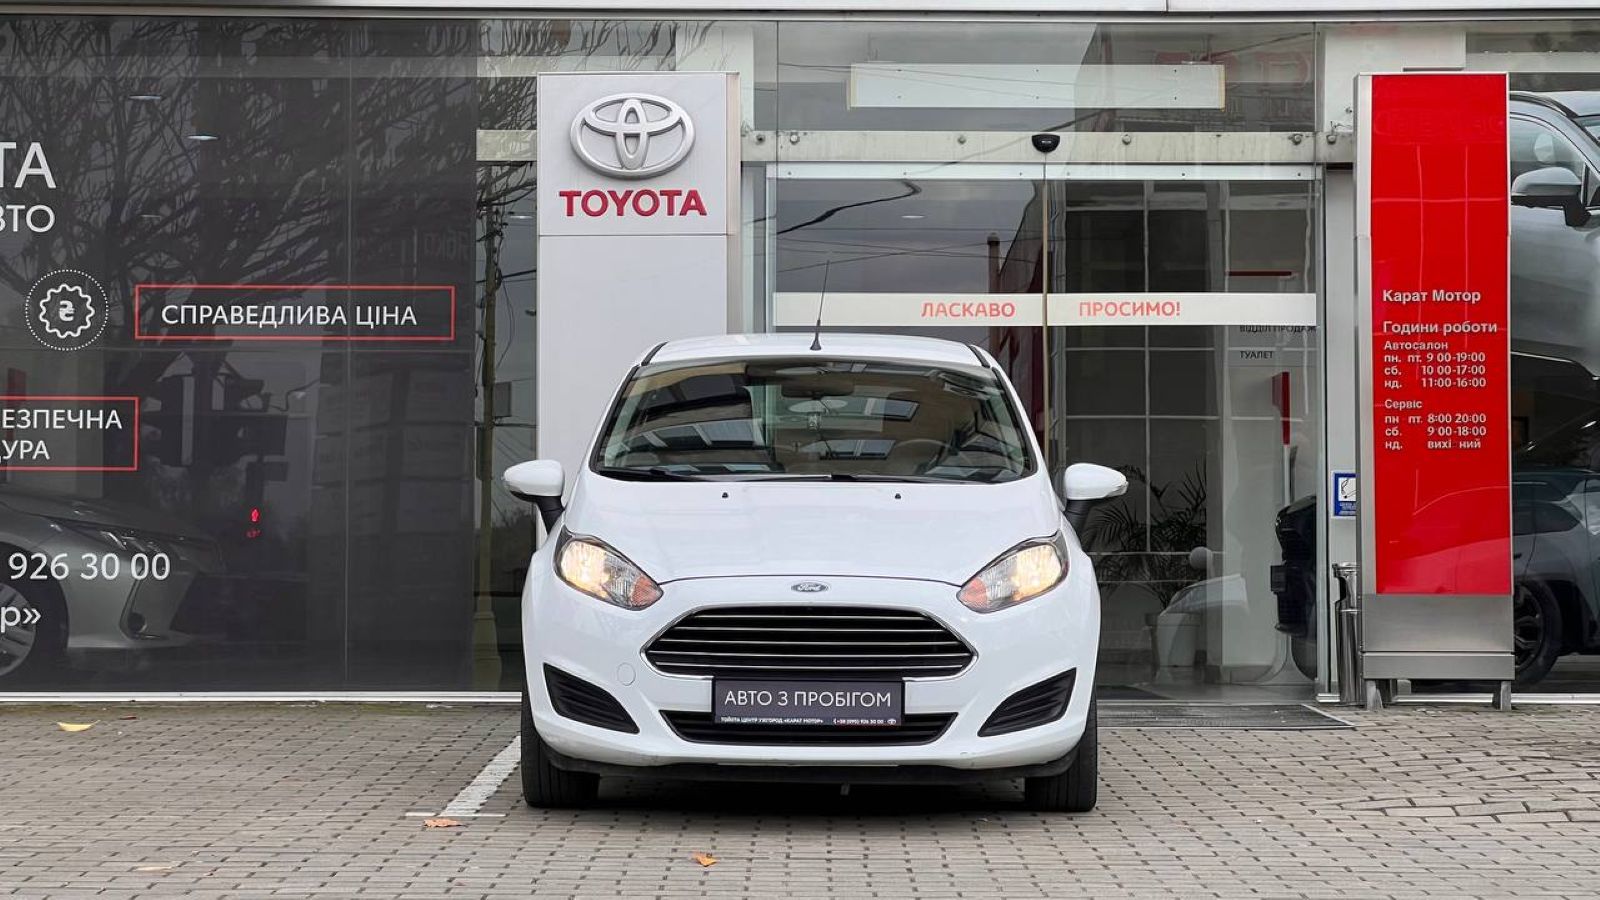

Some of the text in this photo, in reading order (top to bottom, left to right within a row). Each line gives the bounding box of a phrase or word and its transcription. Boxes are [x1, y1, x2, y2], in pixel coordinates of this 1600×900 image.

[559, 189, 708, 217] TOYOTA
[1383, 289, 1481, 305] Карат Мотор
[921, 301, 1181, 318] ЛАСКАВО ПРОСИМО!
[161, 305, 418, 329] СПРАВЕДЛИВА ЦІНА
[1383, 320, 1498, 336] Години роботи
[1384, 341, 1449, 350] Автосалон
[1240, 350, 1274, 359] ТУАЛЕТ
[1384, 354, 1402, 362] пн.
[1407, 354, 1422, 362] пт.
[1384, 366, 1402, 375] сб.
[1384, 377, 1487, 389] нд. 11:00-16:00
[1384, 399, 1423, 411] Сервіс
[2, 409, 123, 430] ЕЗПЕЧНА
[1385, 427, 1403, 436] сб.
[0, 440, 50, 463] УРА
[1385, 441, 1404, 450] нд.
[8, 553, 170, 580] 926 30 00
[797, 583, 821, 592] Ford
[724, 690, 772, 706] АВТО
[794, 691, 891, 707] ПРОБІГОМ
